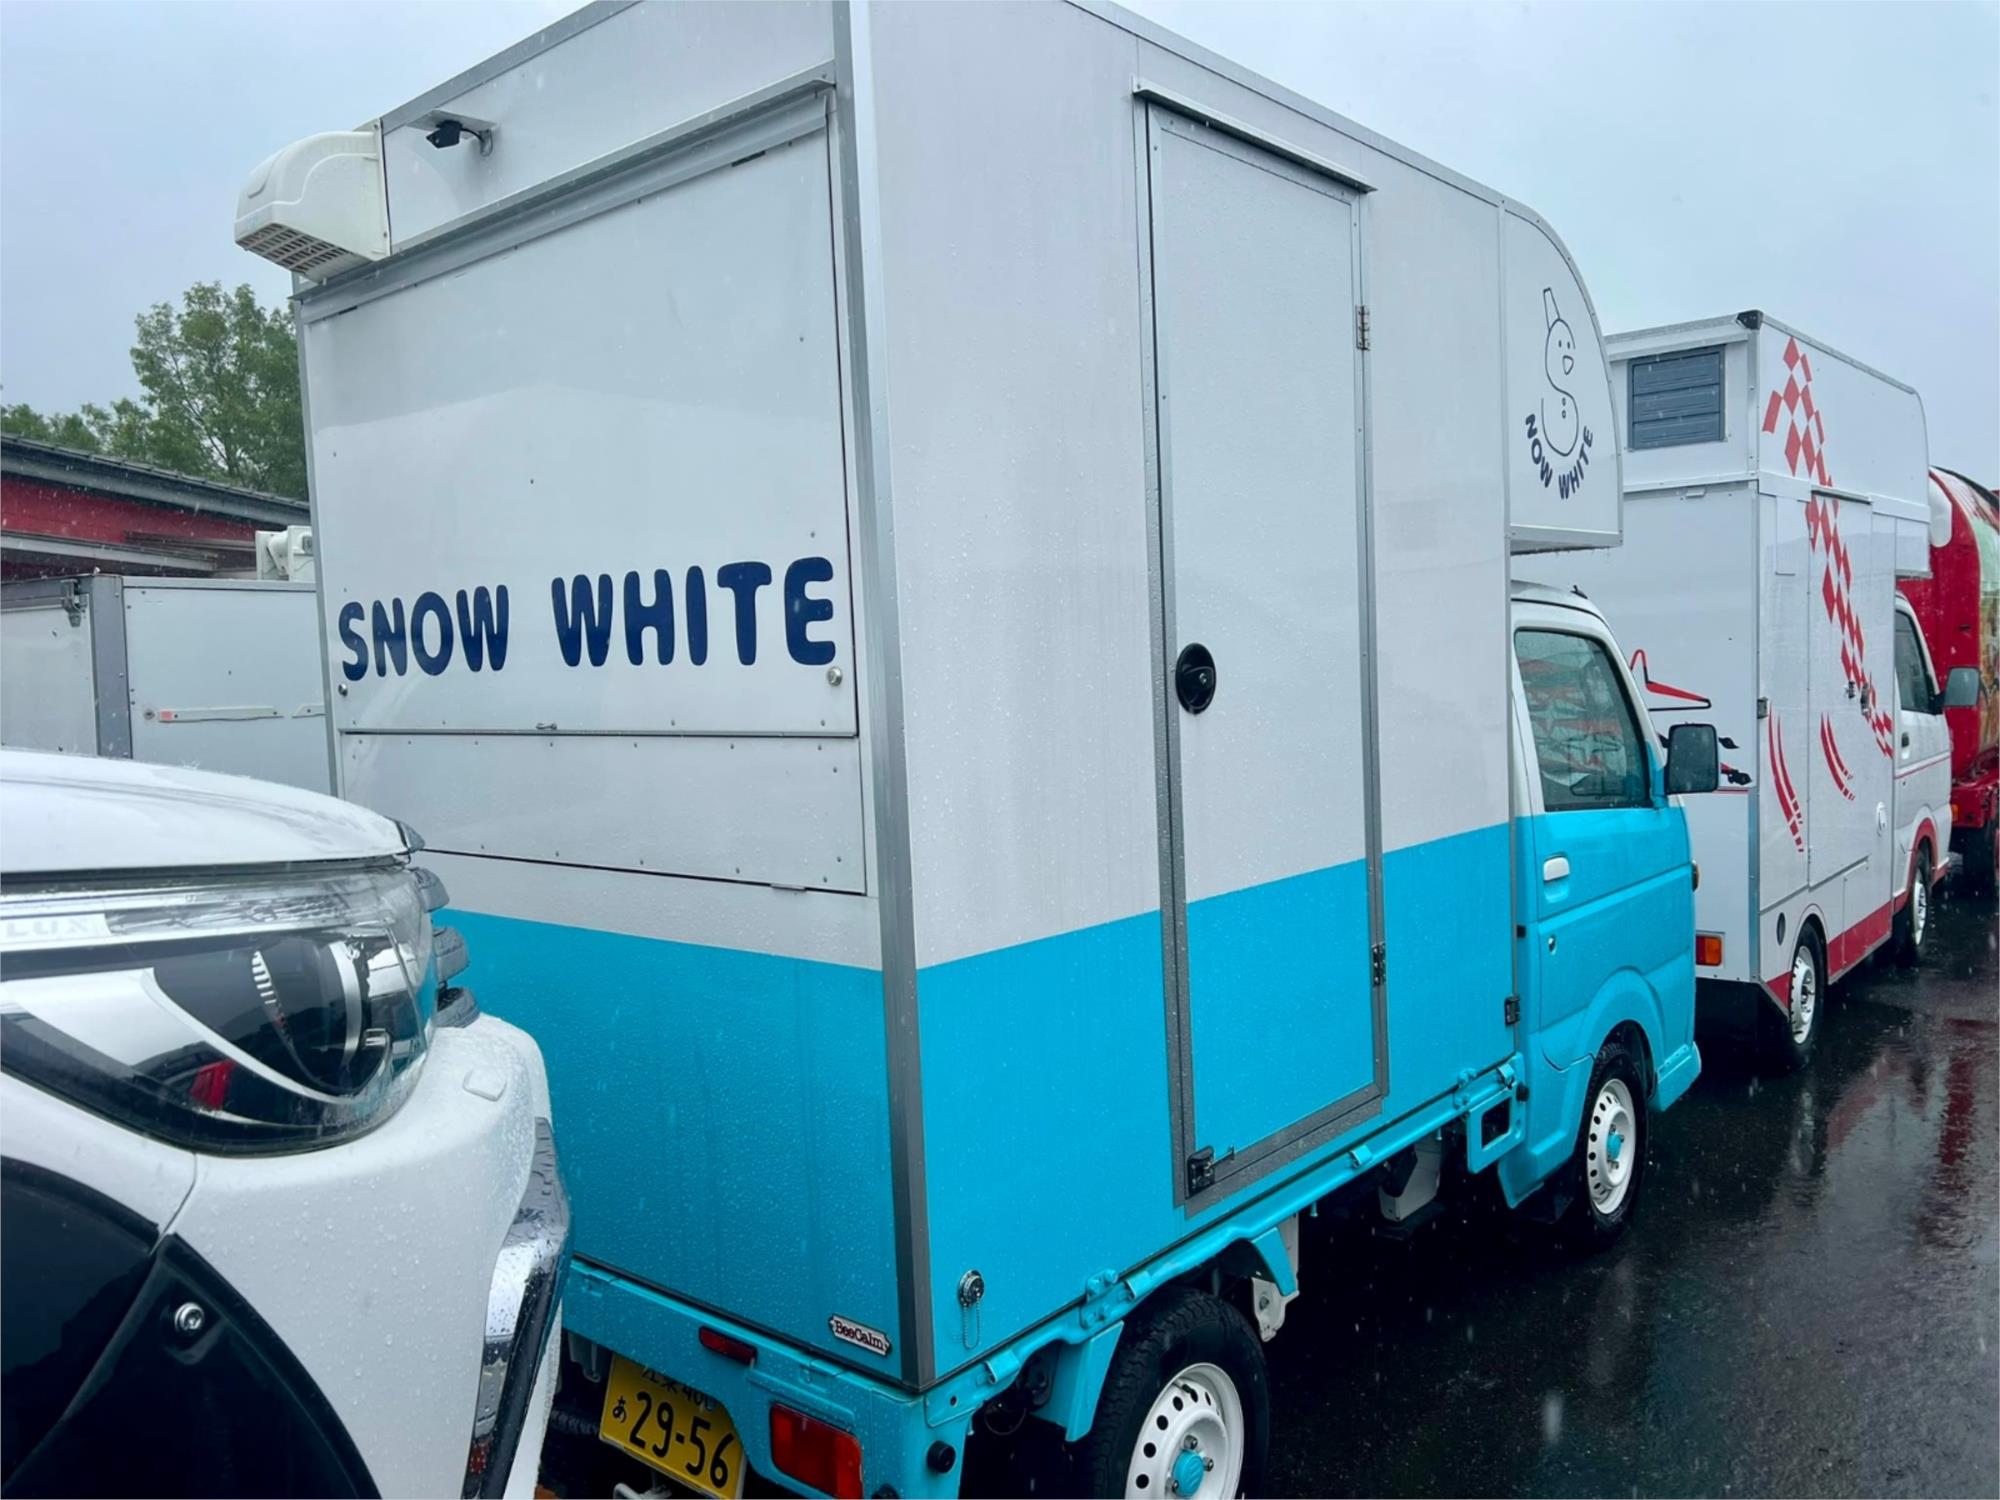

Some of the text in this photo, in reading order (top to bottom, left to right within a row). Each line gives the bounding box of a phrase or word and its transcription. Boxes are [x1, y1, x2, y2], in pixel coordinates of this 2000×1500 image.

[1558, 425, 1593, 500] WHITE
[338, 557, 836, 681] SNOW WHITE
[834, 1320, 885, 1352] BeeCalm
[628, 1391, 735, 1488] 29-56
